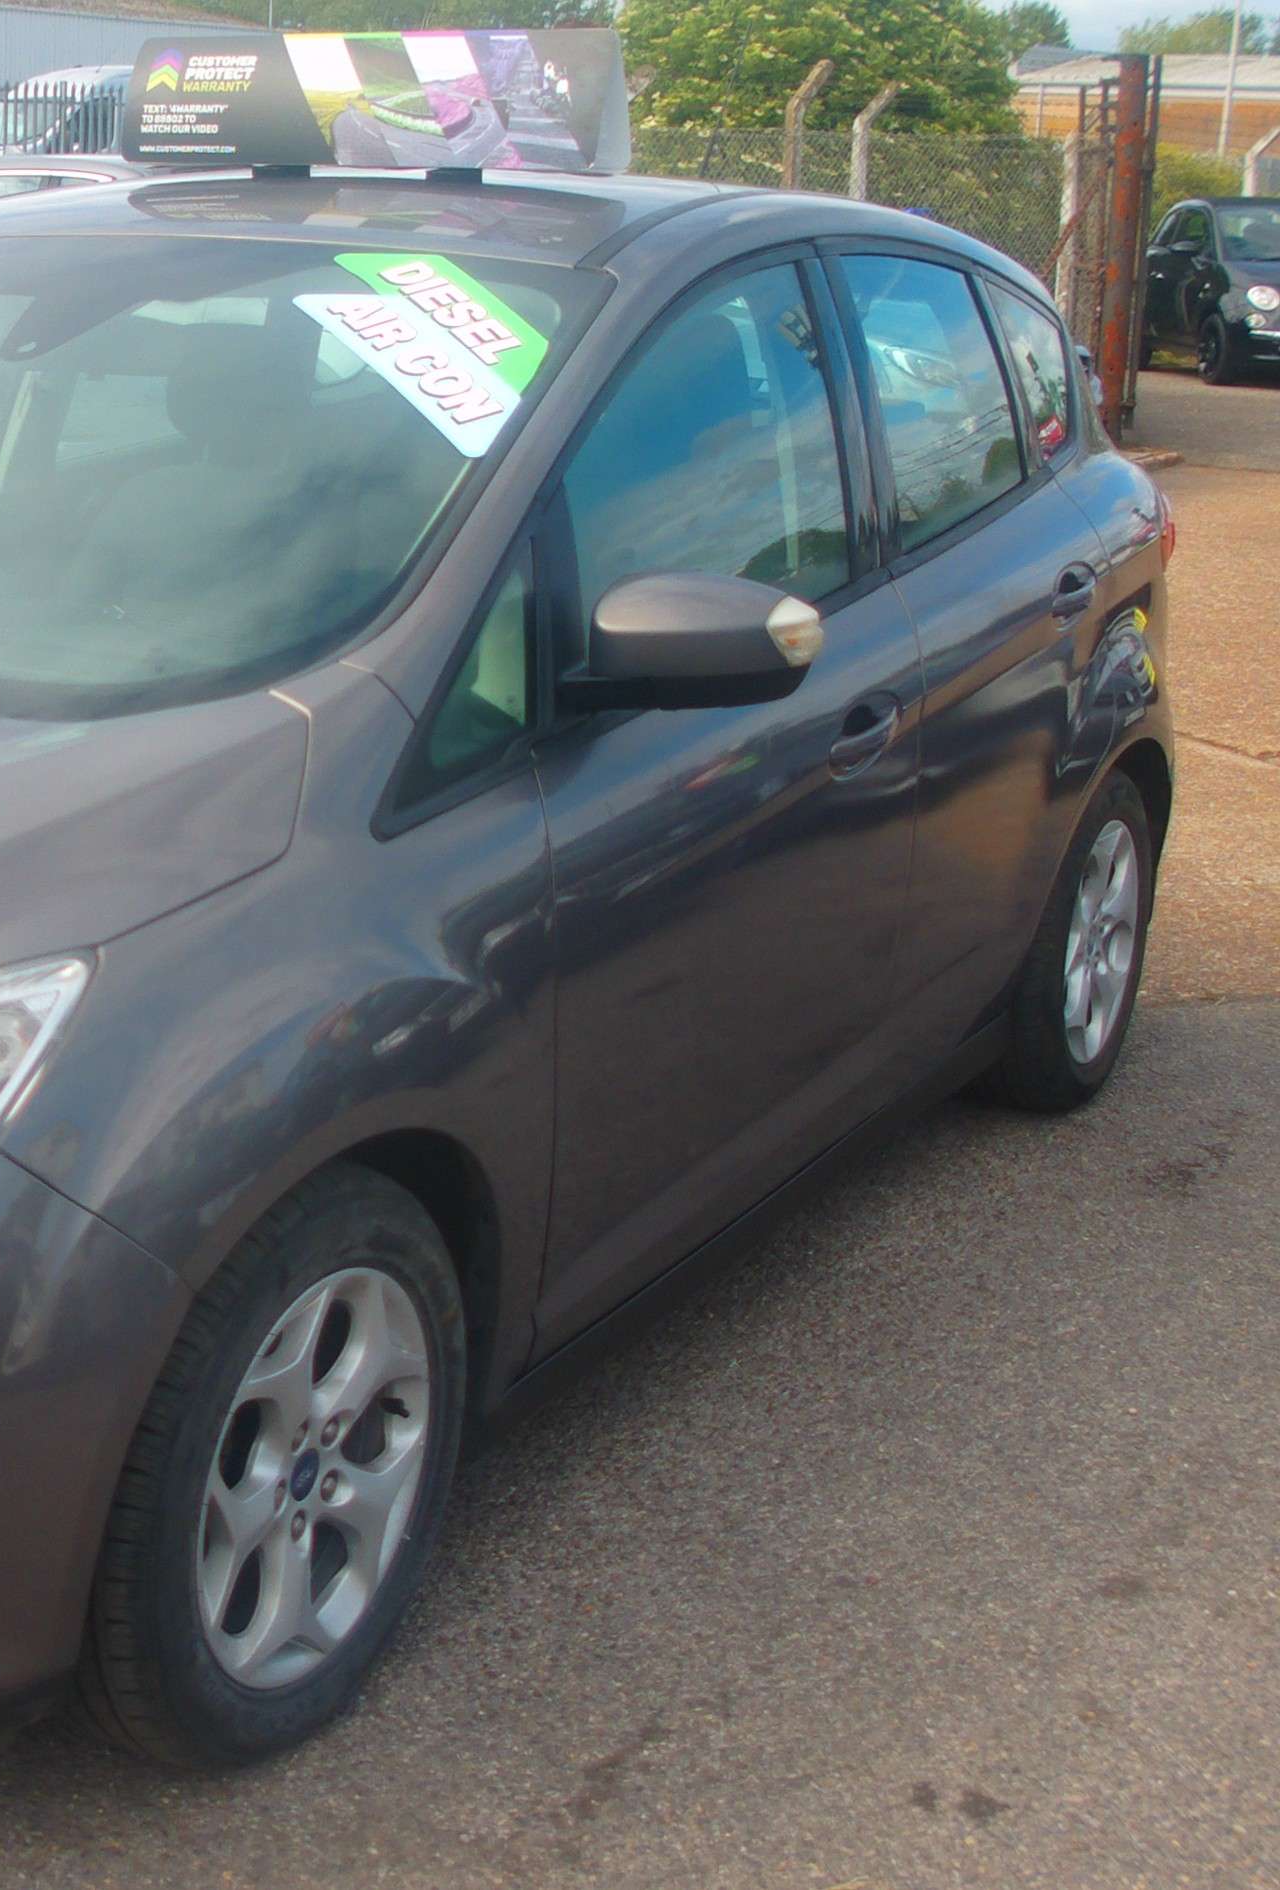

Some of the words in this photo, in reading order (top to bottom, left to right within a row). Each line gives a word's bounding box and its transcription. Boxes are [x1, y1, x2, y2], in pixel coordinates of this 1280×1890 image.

[188, 55, 258, 67] CUSTOMER
[185, 67, 256, 80] PROTECT
[183, 81, 252, 92] WARRANTY
[142, 114, 153, 124] TO
[185, 114, 196, 124] TO
[140, 124, 170, 133] WATCH
[171, 124, 191, 133] OUR
[192, 124, 218, 134] VIDEO
[377, 260, 523, 367] DIESEL
[326, 299, 418, 352] AIR
[394, 349, 505, 425] CON
